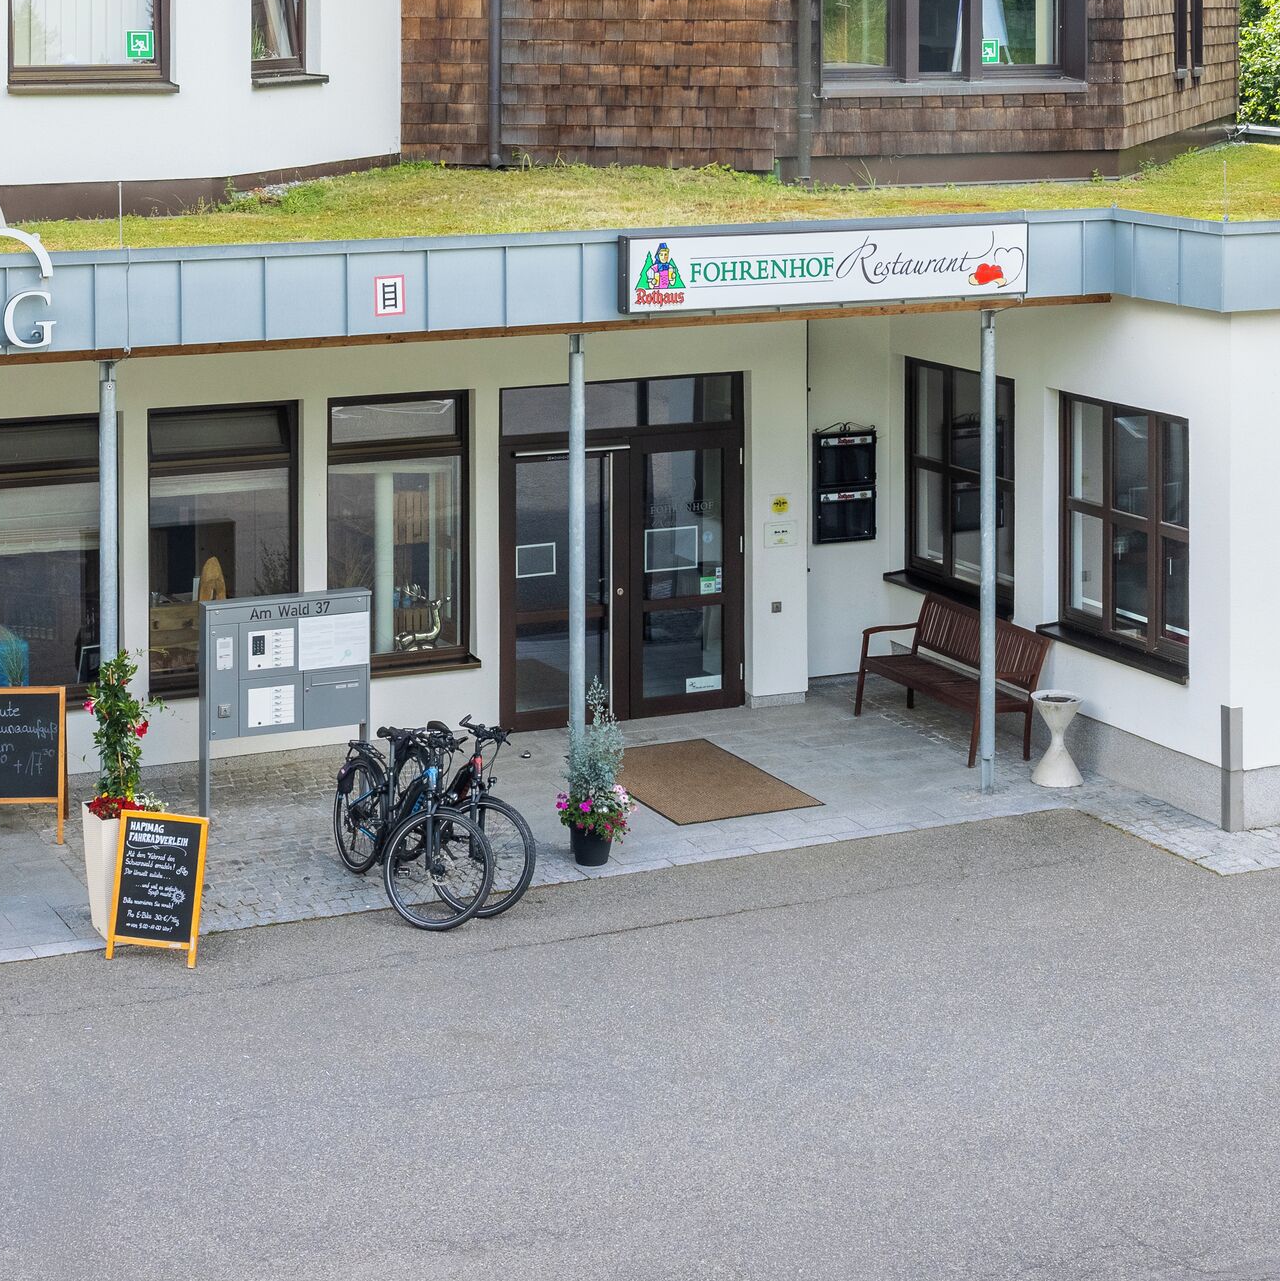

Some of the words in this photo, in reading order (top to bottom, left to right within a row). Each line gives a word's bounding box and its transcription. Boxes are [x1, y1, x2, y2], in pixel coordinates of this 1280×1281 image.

[689, 256, 835, 284] FOHRENHOF
[835, 235, 975, 285] Restaurant
[634, 288, 685, 307] Rothaus
[249, 607, 272, 621] Am
[278, 602, 310, 618] Wald
[315, 601, 331, 614] 37
[130, 821, 164, 833] HAPIMAG
[128, 832, 188, 846] FAHRRADVERLEIH
